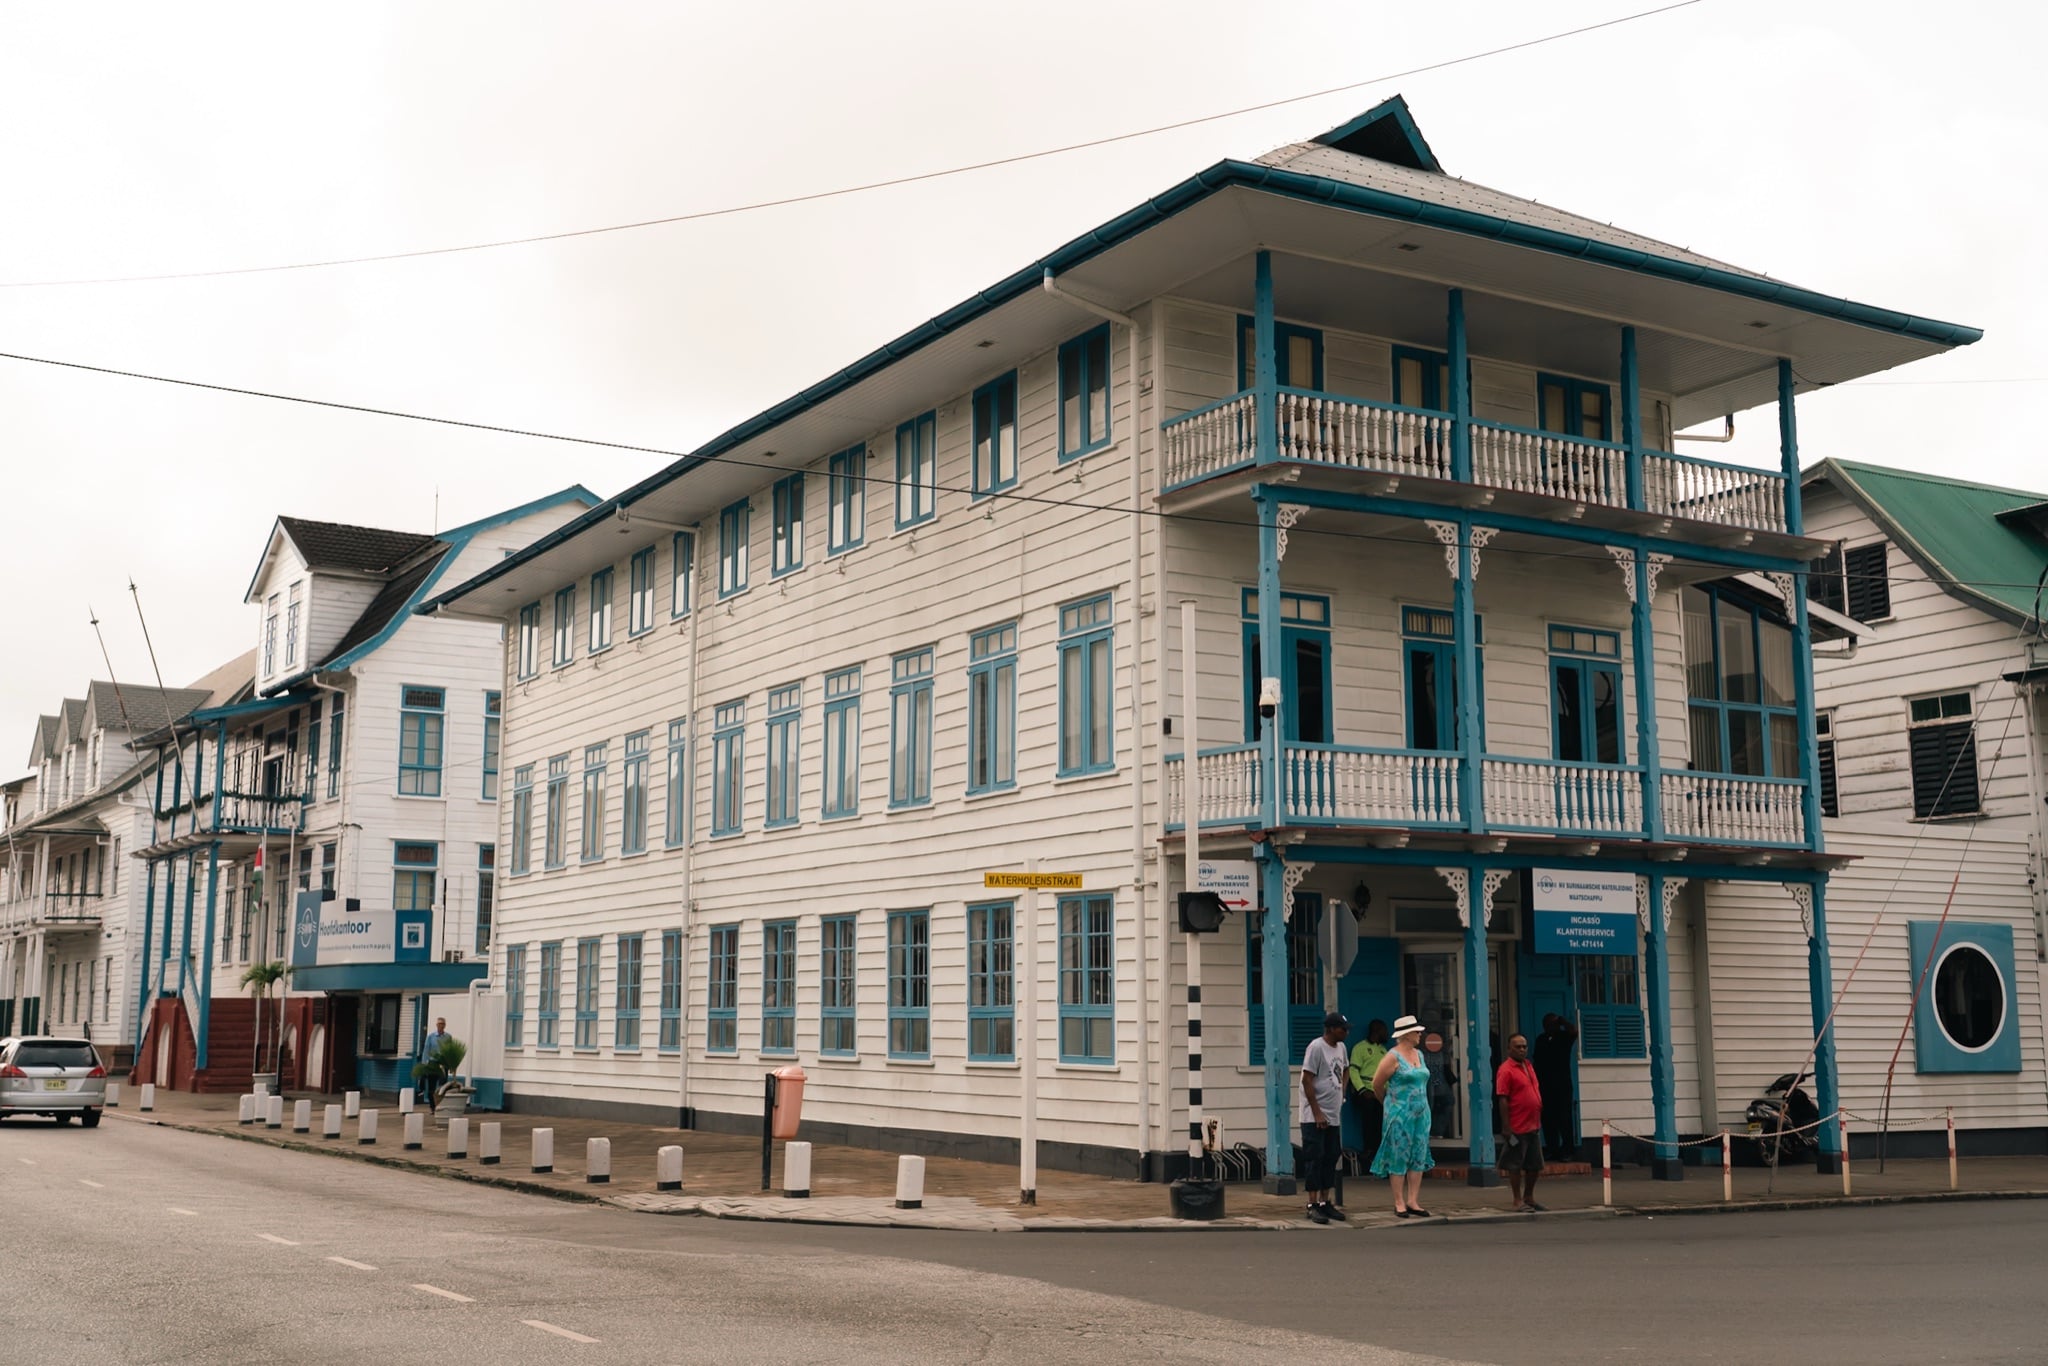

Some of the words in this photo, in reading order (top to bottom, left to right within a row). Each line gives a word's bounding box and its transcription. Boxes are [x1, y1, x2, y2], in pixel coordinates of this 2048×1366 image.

[988, 875, 1080, 886] WATERMOLENSTRAAT
[1570, 916, 1601, 925] INCASSO
[319, 920, 371, 936] Hoofdkantoor
[1556, 927, 1615, 937] KLANTENSERVICE
[1569, 940, 1580, 948] Tel.
[1581, 940, 1604, 948] 471414
